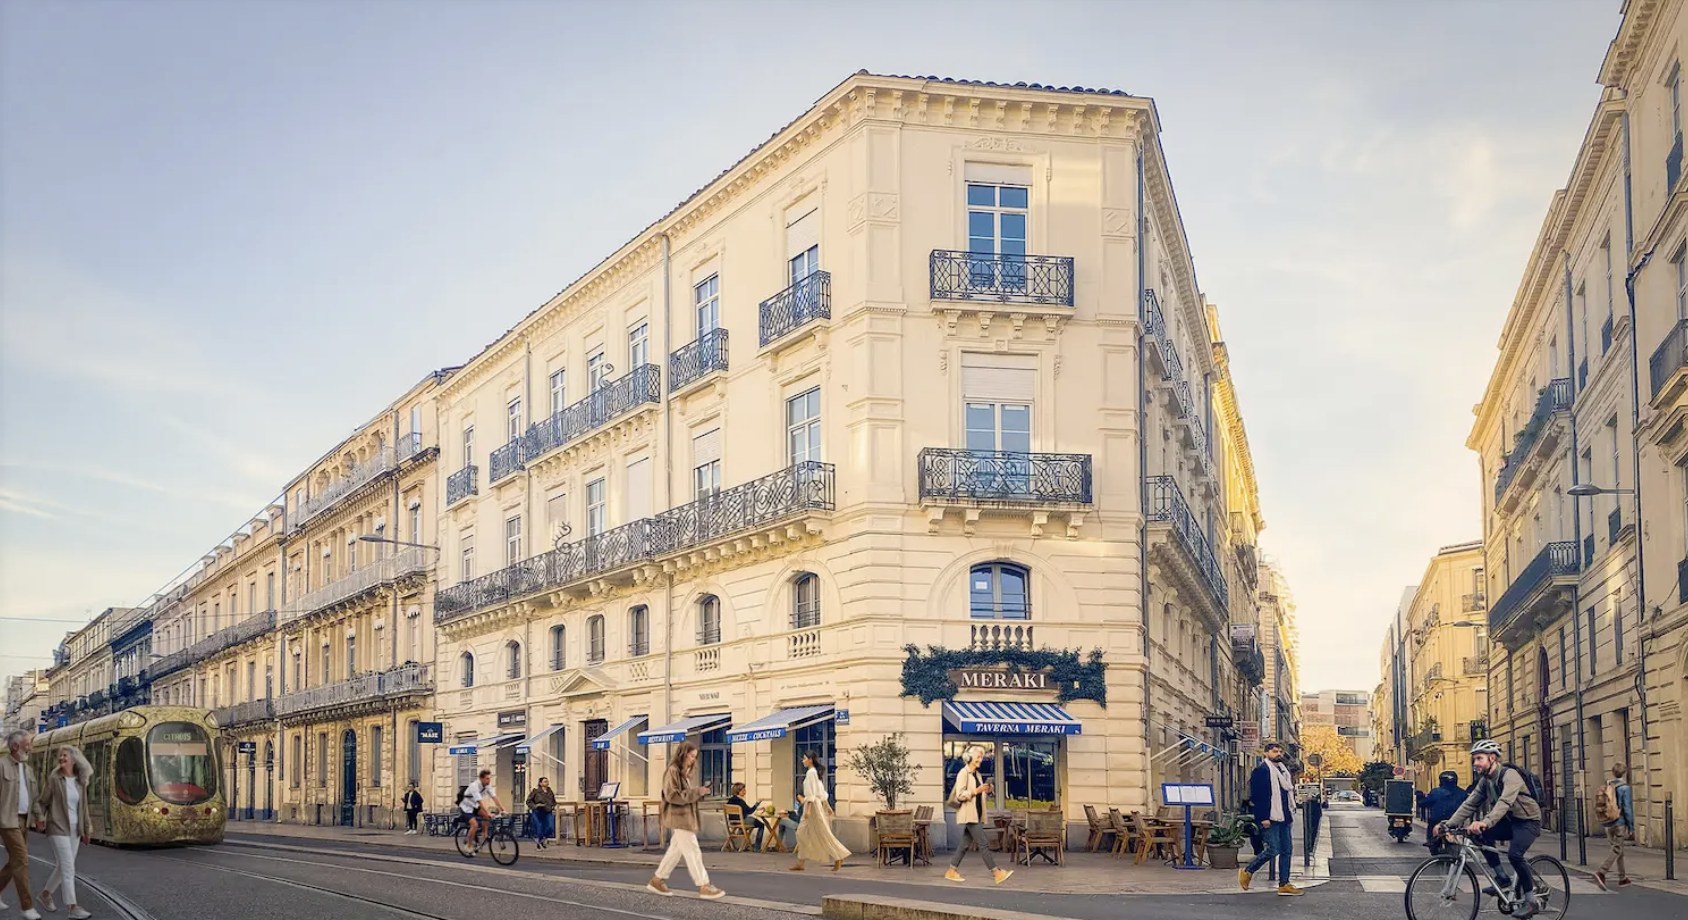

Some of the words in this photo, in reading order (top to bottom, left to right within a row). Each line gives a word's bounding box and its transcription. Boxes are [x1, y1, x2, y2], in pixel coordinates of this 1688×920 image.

[961, 672, 1045, 688] MERAKI
[975, 723, 1020, 732] TAVERNA
[1025, 725, 1066, 733] MERAKI
